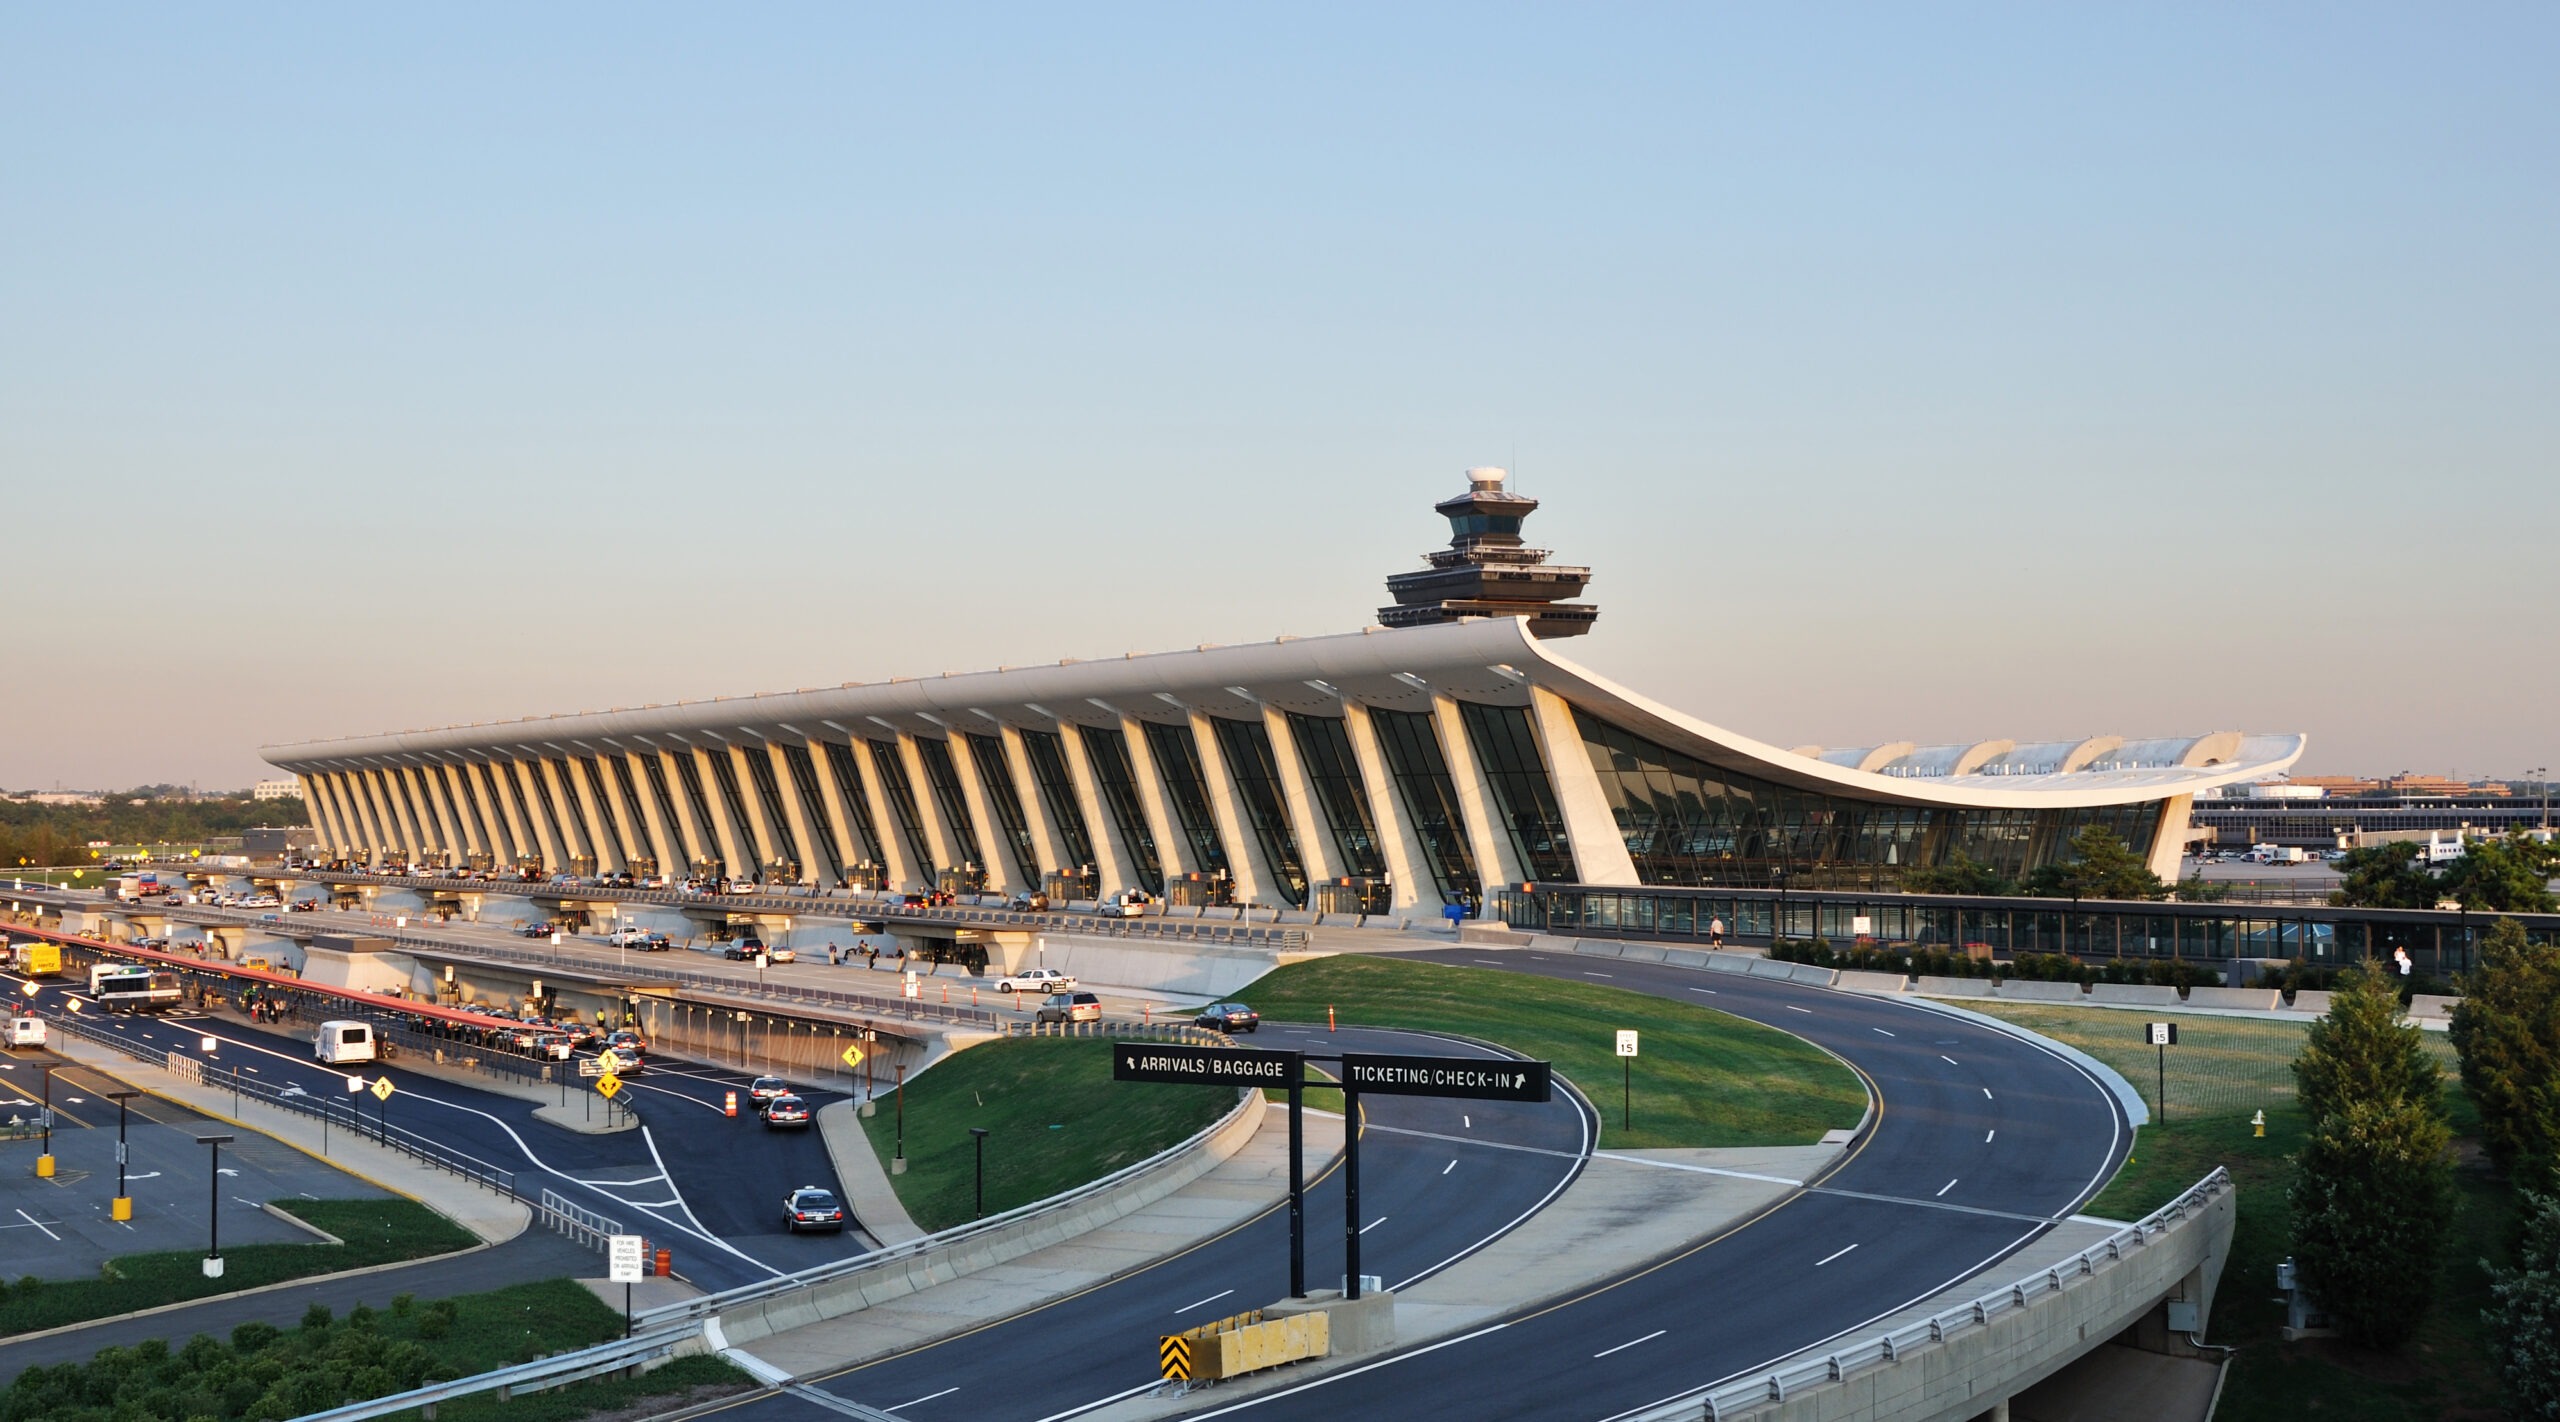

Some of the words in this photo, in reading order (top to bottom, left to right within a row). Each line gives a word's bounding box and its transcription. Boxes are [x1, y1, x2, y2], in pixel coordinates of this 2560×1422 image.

[2155, 1033, 2166, 1042] 15
[1621, 1043, 1633, 1053] 15
[1140, 1056, 1284, 1077] ARRIVALS/BAGGAGE
[1353, 1066, 1510, 1088] TICKETING/CHECK-IN
